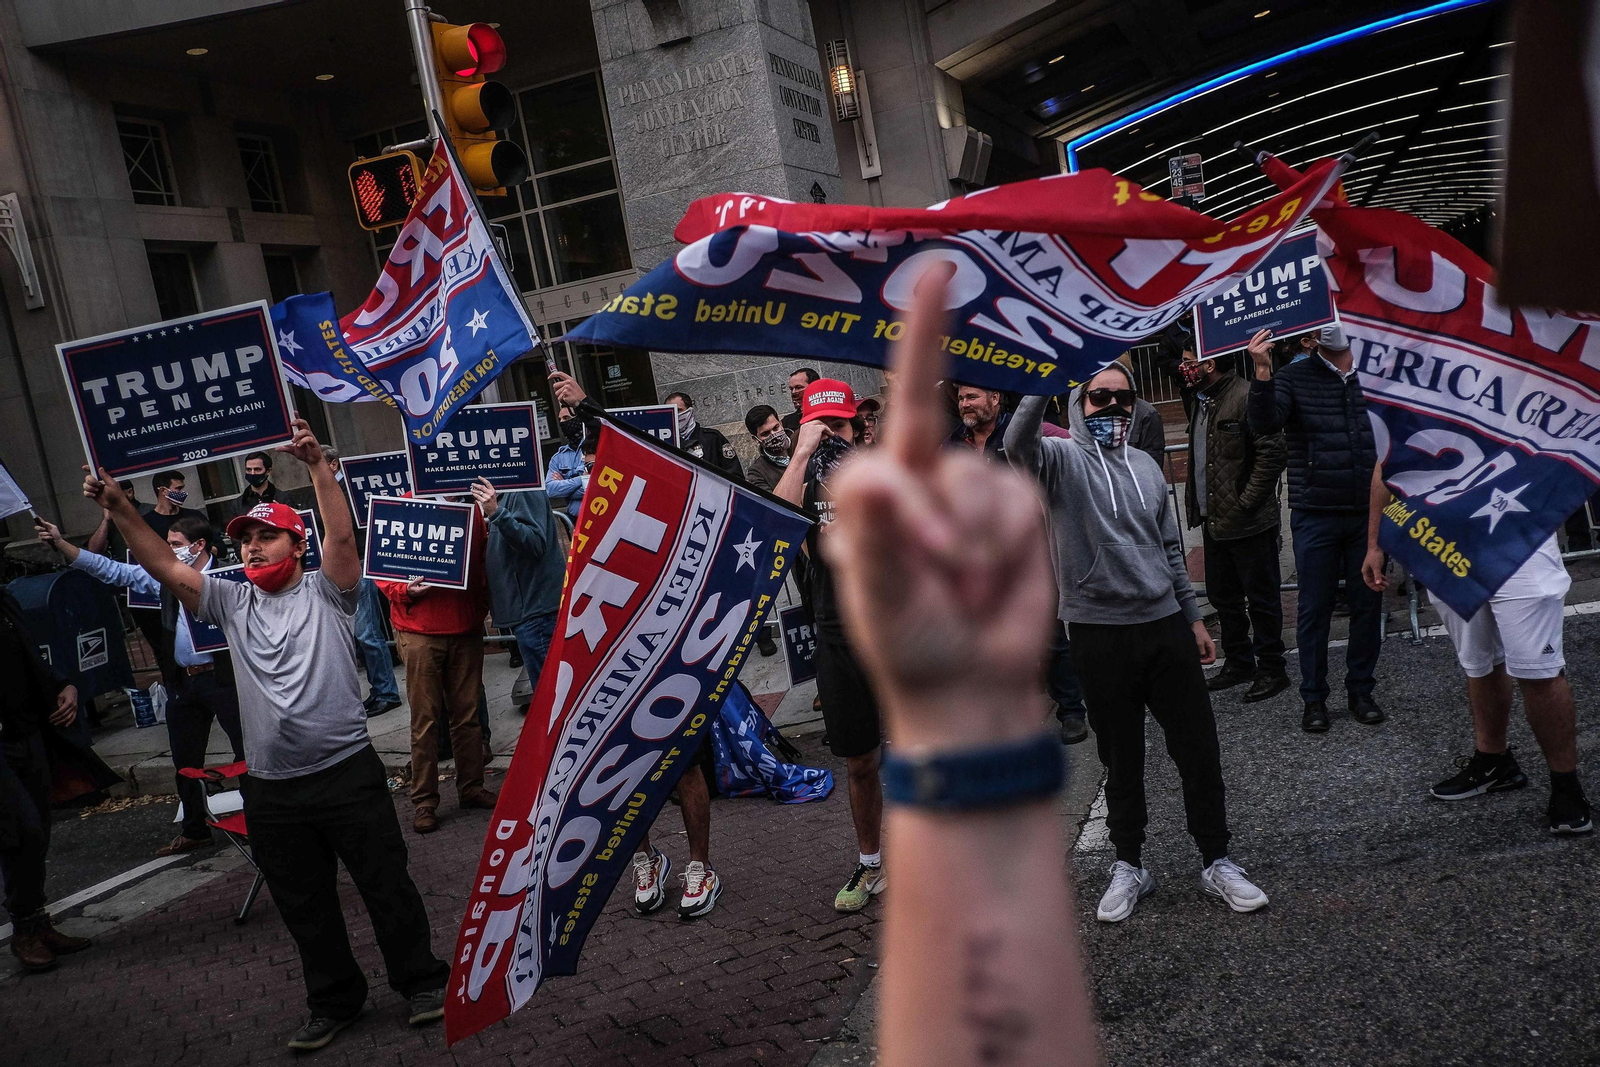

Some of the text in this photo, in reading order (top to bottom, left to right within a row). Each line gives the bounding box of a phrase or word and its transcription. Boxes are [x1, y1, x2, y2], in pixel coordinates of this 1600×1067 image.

[617, 54, 754, 108] PENNSYLVANIA
[767, 51, 822, 92] PENNSYLVANIA
[634, 86, 746, 135] CONVENTION
[779, 84, 824, 118] CONVENTION
[660, 122, 729, 159] CENTER
[792, 117, 821, 144] CENTER
[1171, 168, 1182, 178] 23
[1172, 178, 1184, 187] 45
[1213, 279, 1312, 320] PENCE
[1225, 316, 1242, 327] KEEP
[1243, 307, 1275, 321] AMERICA
[1275, 299, 1302, 311] GREAT!
[81, 296, 265, 406] TRUMP
[107, 377, 256, 425] PENCE
[354, 375, 399, 410] NITED
[1346, 334, 1600, 446] ERICA GREA
[107, 427, 138, 442] MAKE
[140, 417, 189, 435] AMERICA
[190, 408, 225, 424] GREAT
[228, 400, 266, 416] AGAIN!
[419, 426, 530, 450] RUMP
[182, 448, 209, 462] 2020
[427, 447, 521, 463] PENCE
[446, 464, 477, 472] AMERICA
[374, 518, 465, 542] TRUMP
[381, 537, 455, 555] PENCE
[1408, 516, 1472, 578] States
[393, 553, 417, 561] AMERICA
[418, 555, 436, 563] GREAT
[437, 557, 457, 565] AGAIN!
